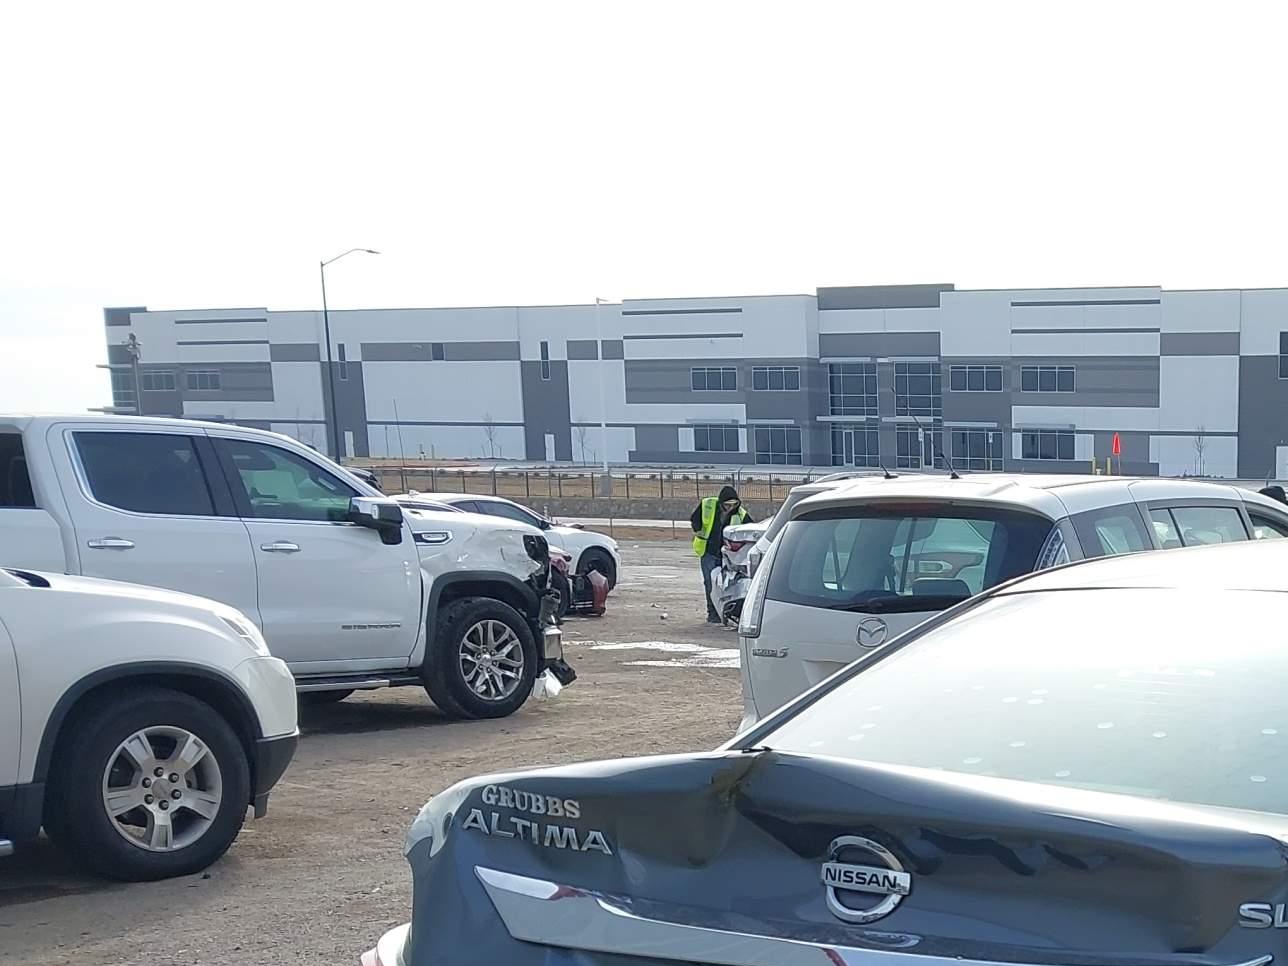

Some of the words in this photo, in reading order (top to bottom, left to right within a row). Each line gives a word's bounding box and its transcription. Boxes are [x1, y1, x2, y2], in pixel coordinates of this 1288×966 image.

[482, 784, 581, 819] GRUBBS
[462, 808, 613, 855] ALTIMA
[825, 867, 897, 889] NISSAN
